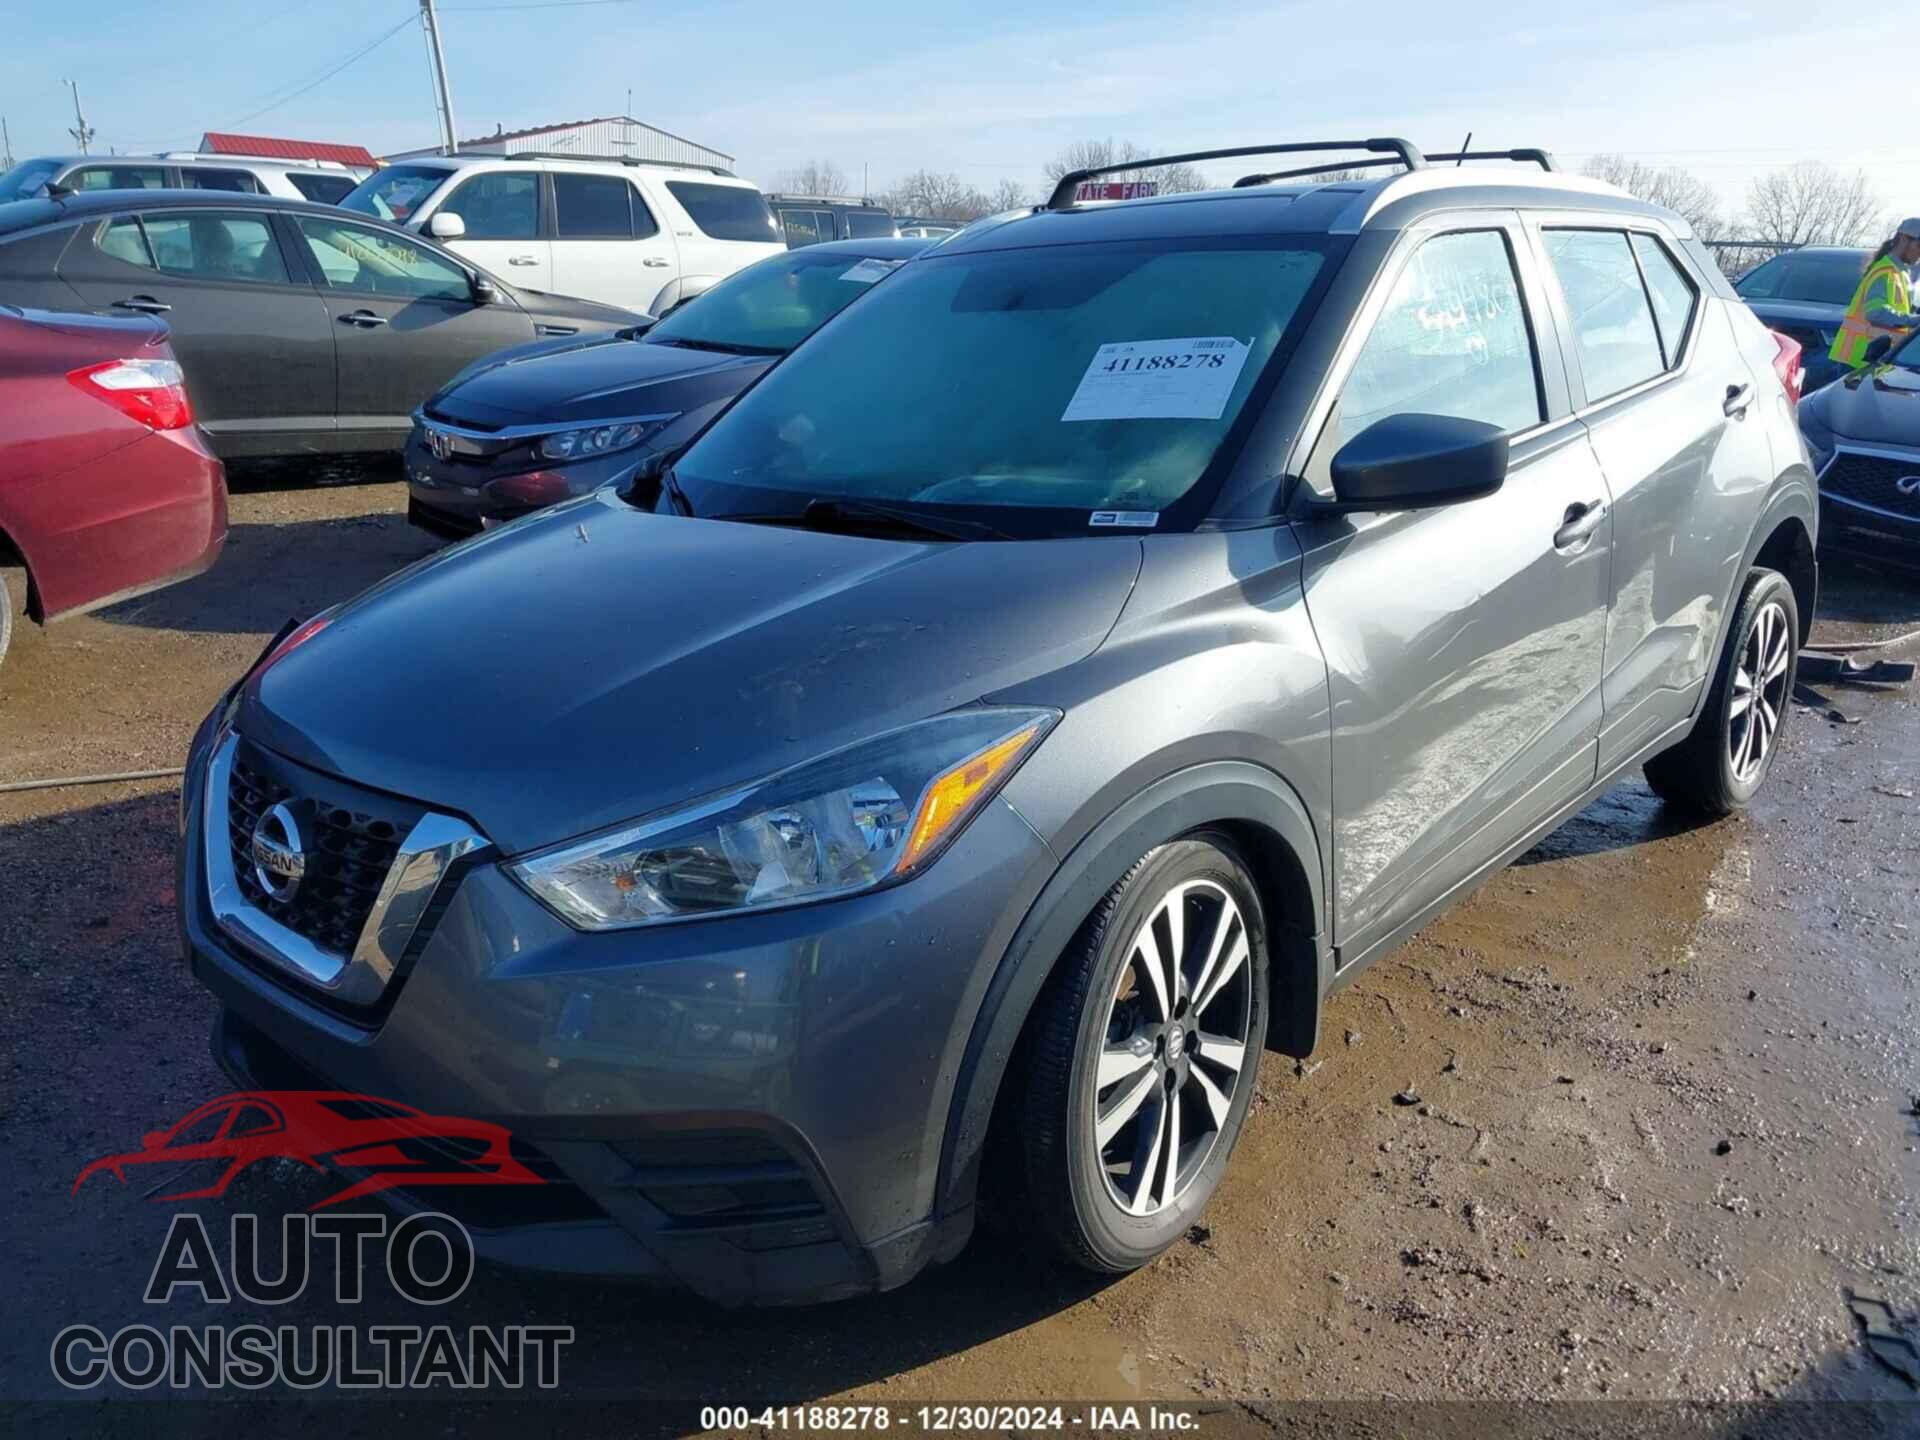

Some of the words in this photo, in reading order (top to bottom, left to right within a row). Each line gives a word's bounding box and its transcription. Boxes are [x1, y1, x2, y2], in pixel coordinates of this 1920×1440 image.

[1075, 183, 1110, 200] TATE
[1103, 353, 1226, 373] 41188278
[256, 842, 292, 873] SSAN
